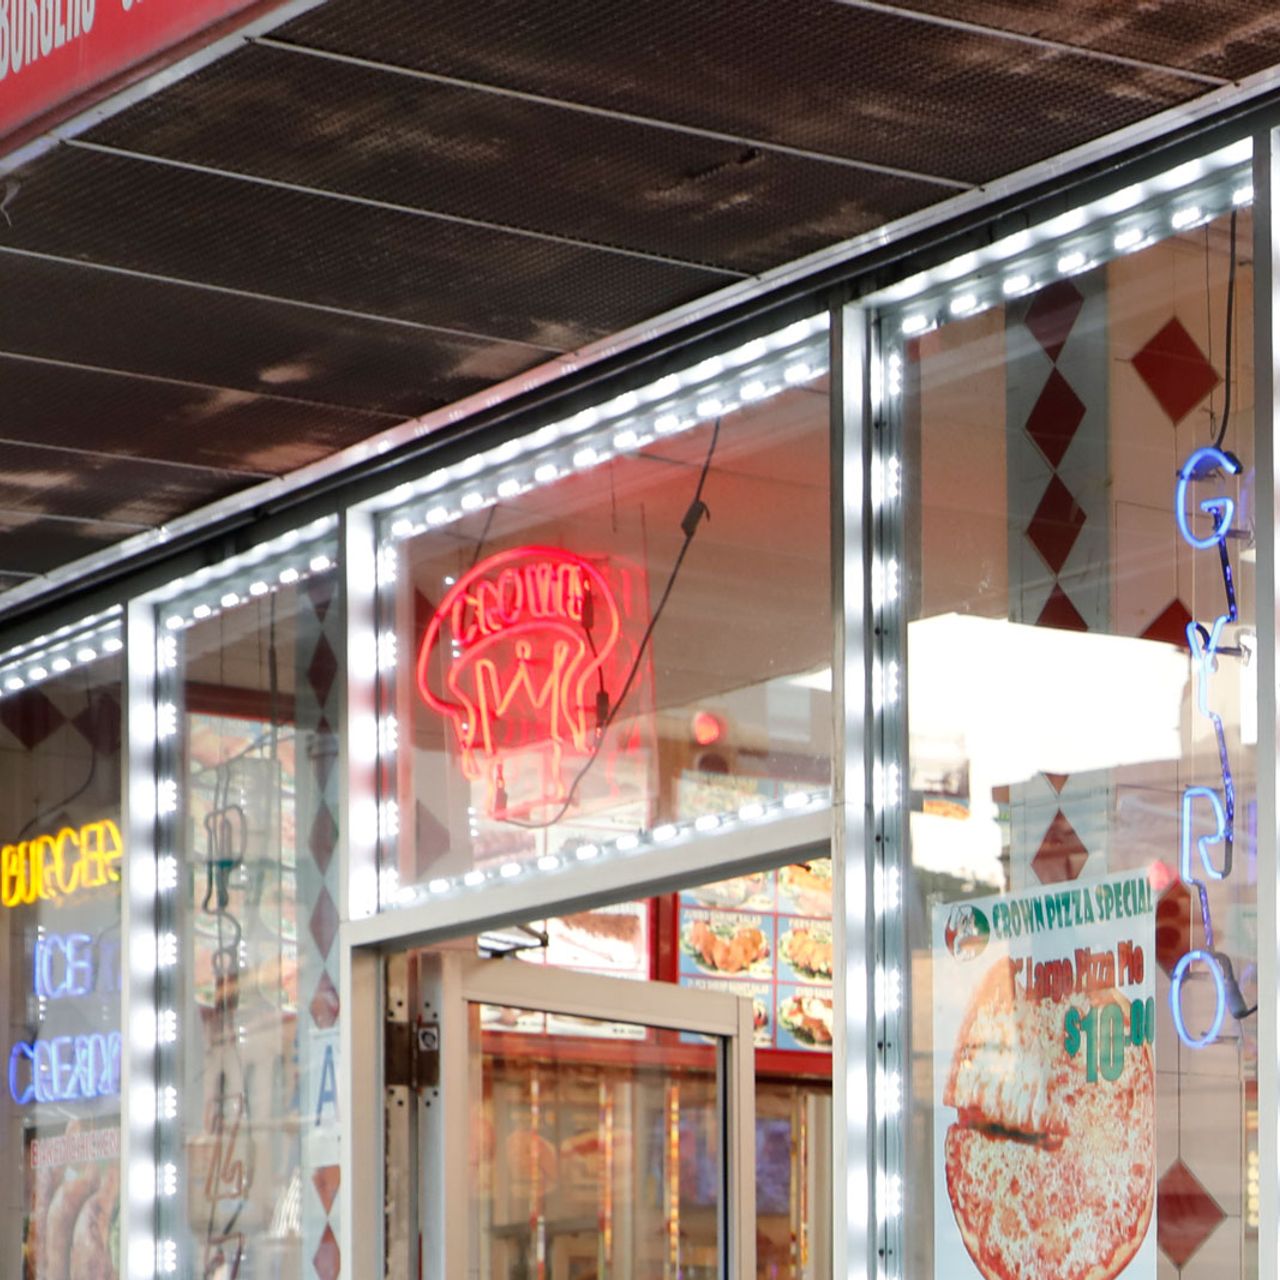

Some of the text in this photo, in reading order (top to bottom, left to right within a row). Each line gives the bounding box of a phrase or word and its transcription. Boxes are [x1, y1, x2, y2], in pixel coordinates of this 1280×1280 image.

[1170, 446, 1244, 1050] GYRO
[1, 820, 123, 907] BURGER
[992, 877, 1154, 939] CROWN PIZZA SPECIAL
[34, 932, 93, 999] ICE
[1075, 947, 1115, 994] Pizza
[1118, 939, 1145, 987] Pie
